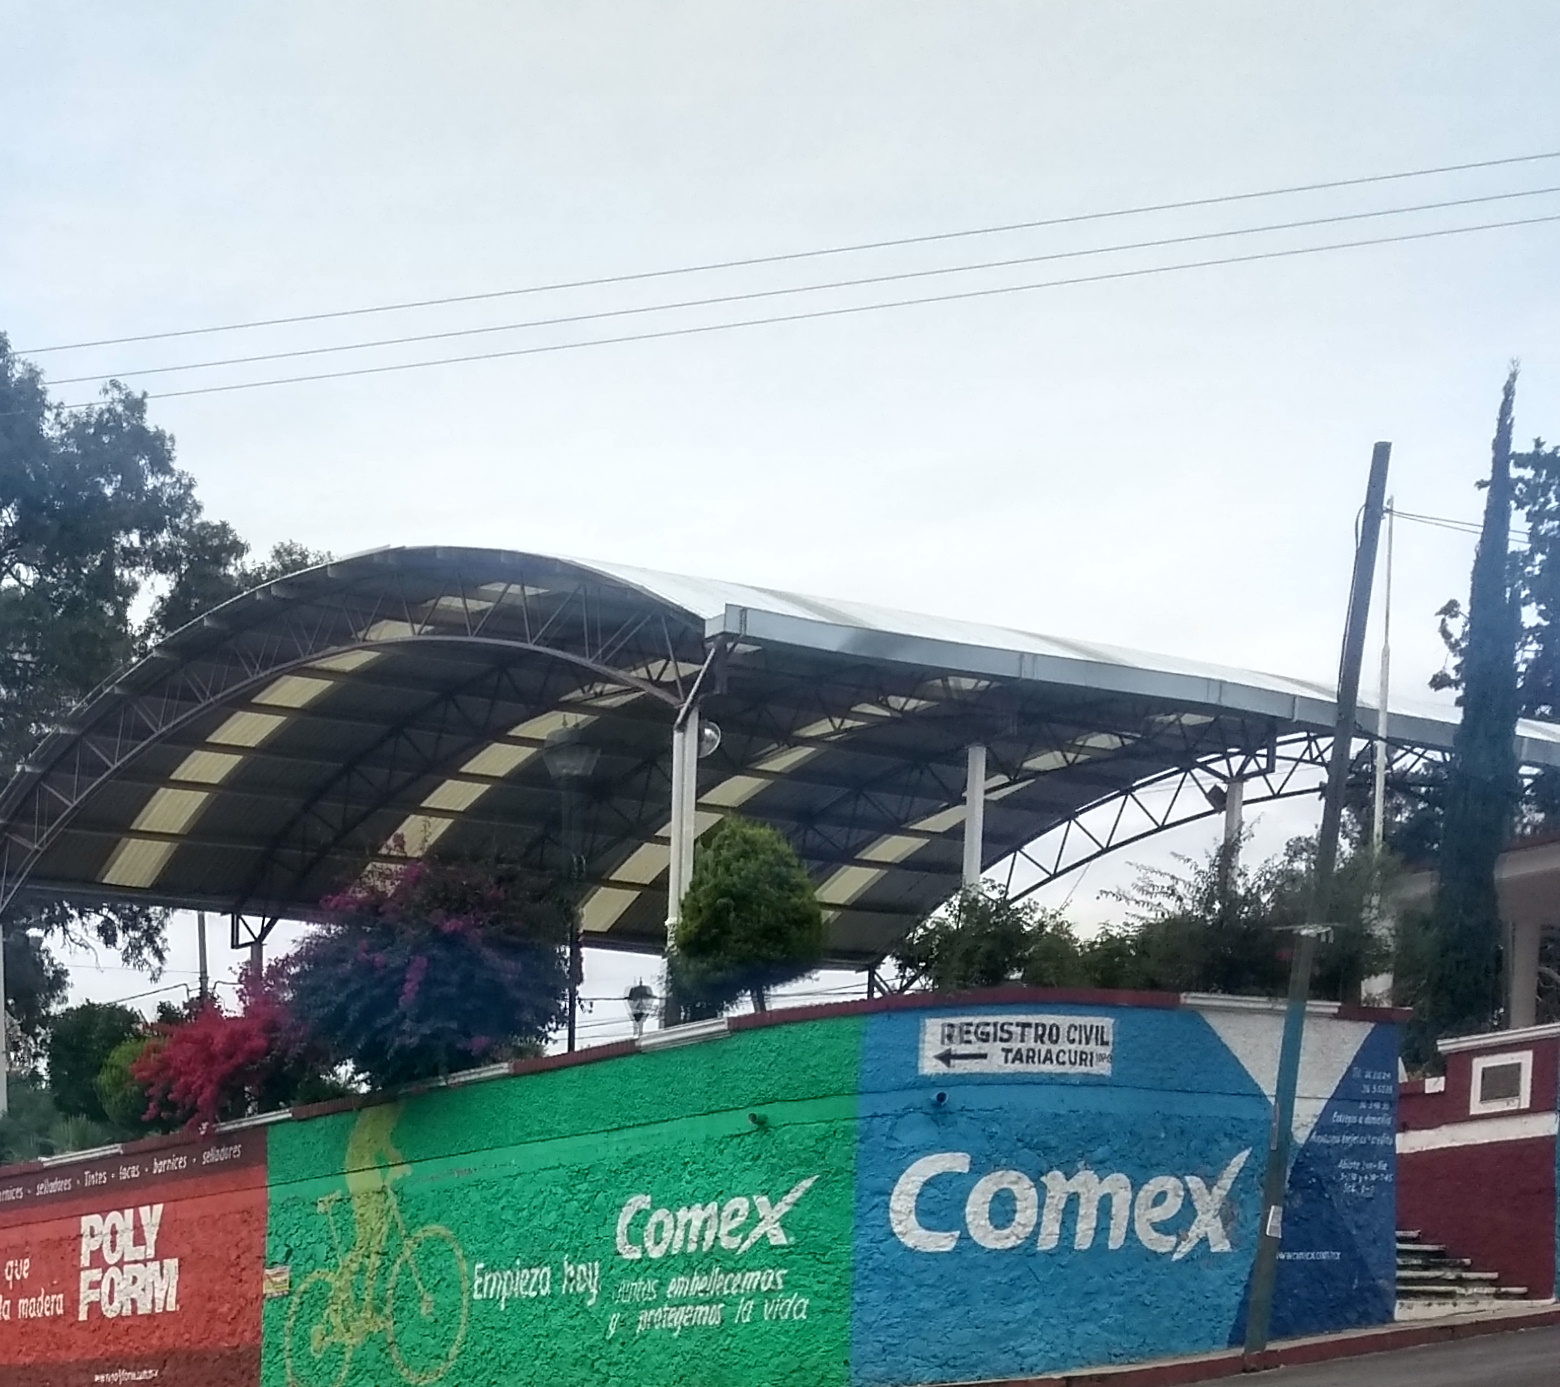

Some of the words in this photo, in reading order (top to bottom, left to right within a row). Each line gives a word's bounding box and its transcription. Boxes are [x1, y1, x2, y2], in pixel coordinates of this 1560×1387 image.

[940, 1021, 1061, 1046] REGISTRO
[1066, 1023, 1110, 1046] CIVIL
[1001, 1047, 1094, 1067] TARIACURI
[36, 1175, 73, 1198] selladores
[83, 1169, 107, 1188] Tintes
[119, 1164, 140, 1181] lacas
[152, 1153, 188, 1175] barnices
[201, 1143, 243, 1166] selladores
[615, 1174, 821, 1260] Comex
[889, 1147, 1253, 1262] Comex
[80, 1203, 164, 1268] POLY
[4, 1255, 30, 1291] que
[78, 1257, 181, 1322] FORM
[473, 1257, 552, 1311] Empieza
[666, 1265, 788, 1299] embellecemos
[17, 1287, 64, 1320] madera
[636, 1301, 726, 1338] protegemos
[734, 1296, 755, 1324] la
[762, 1291, 810, 1321] vida
